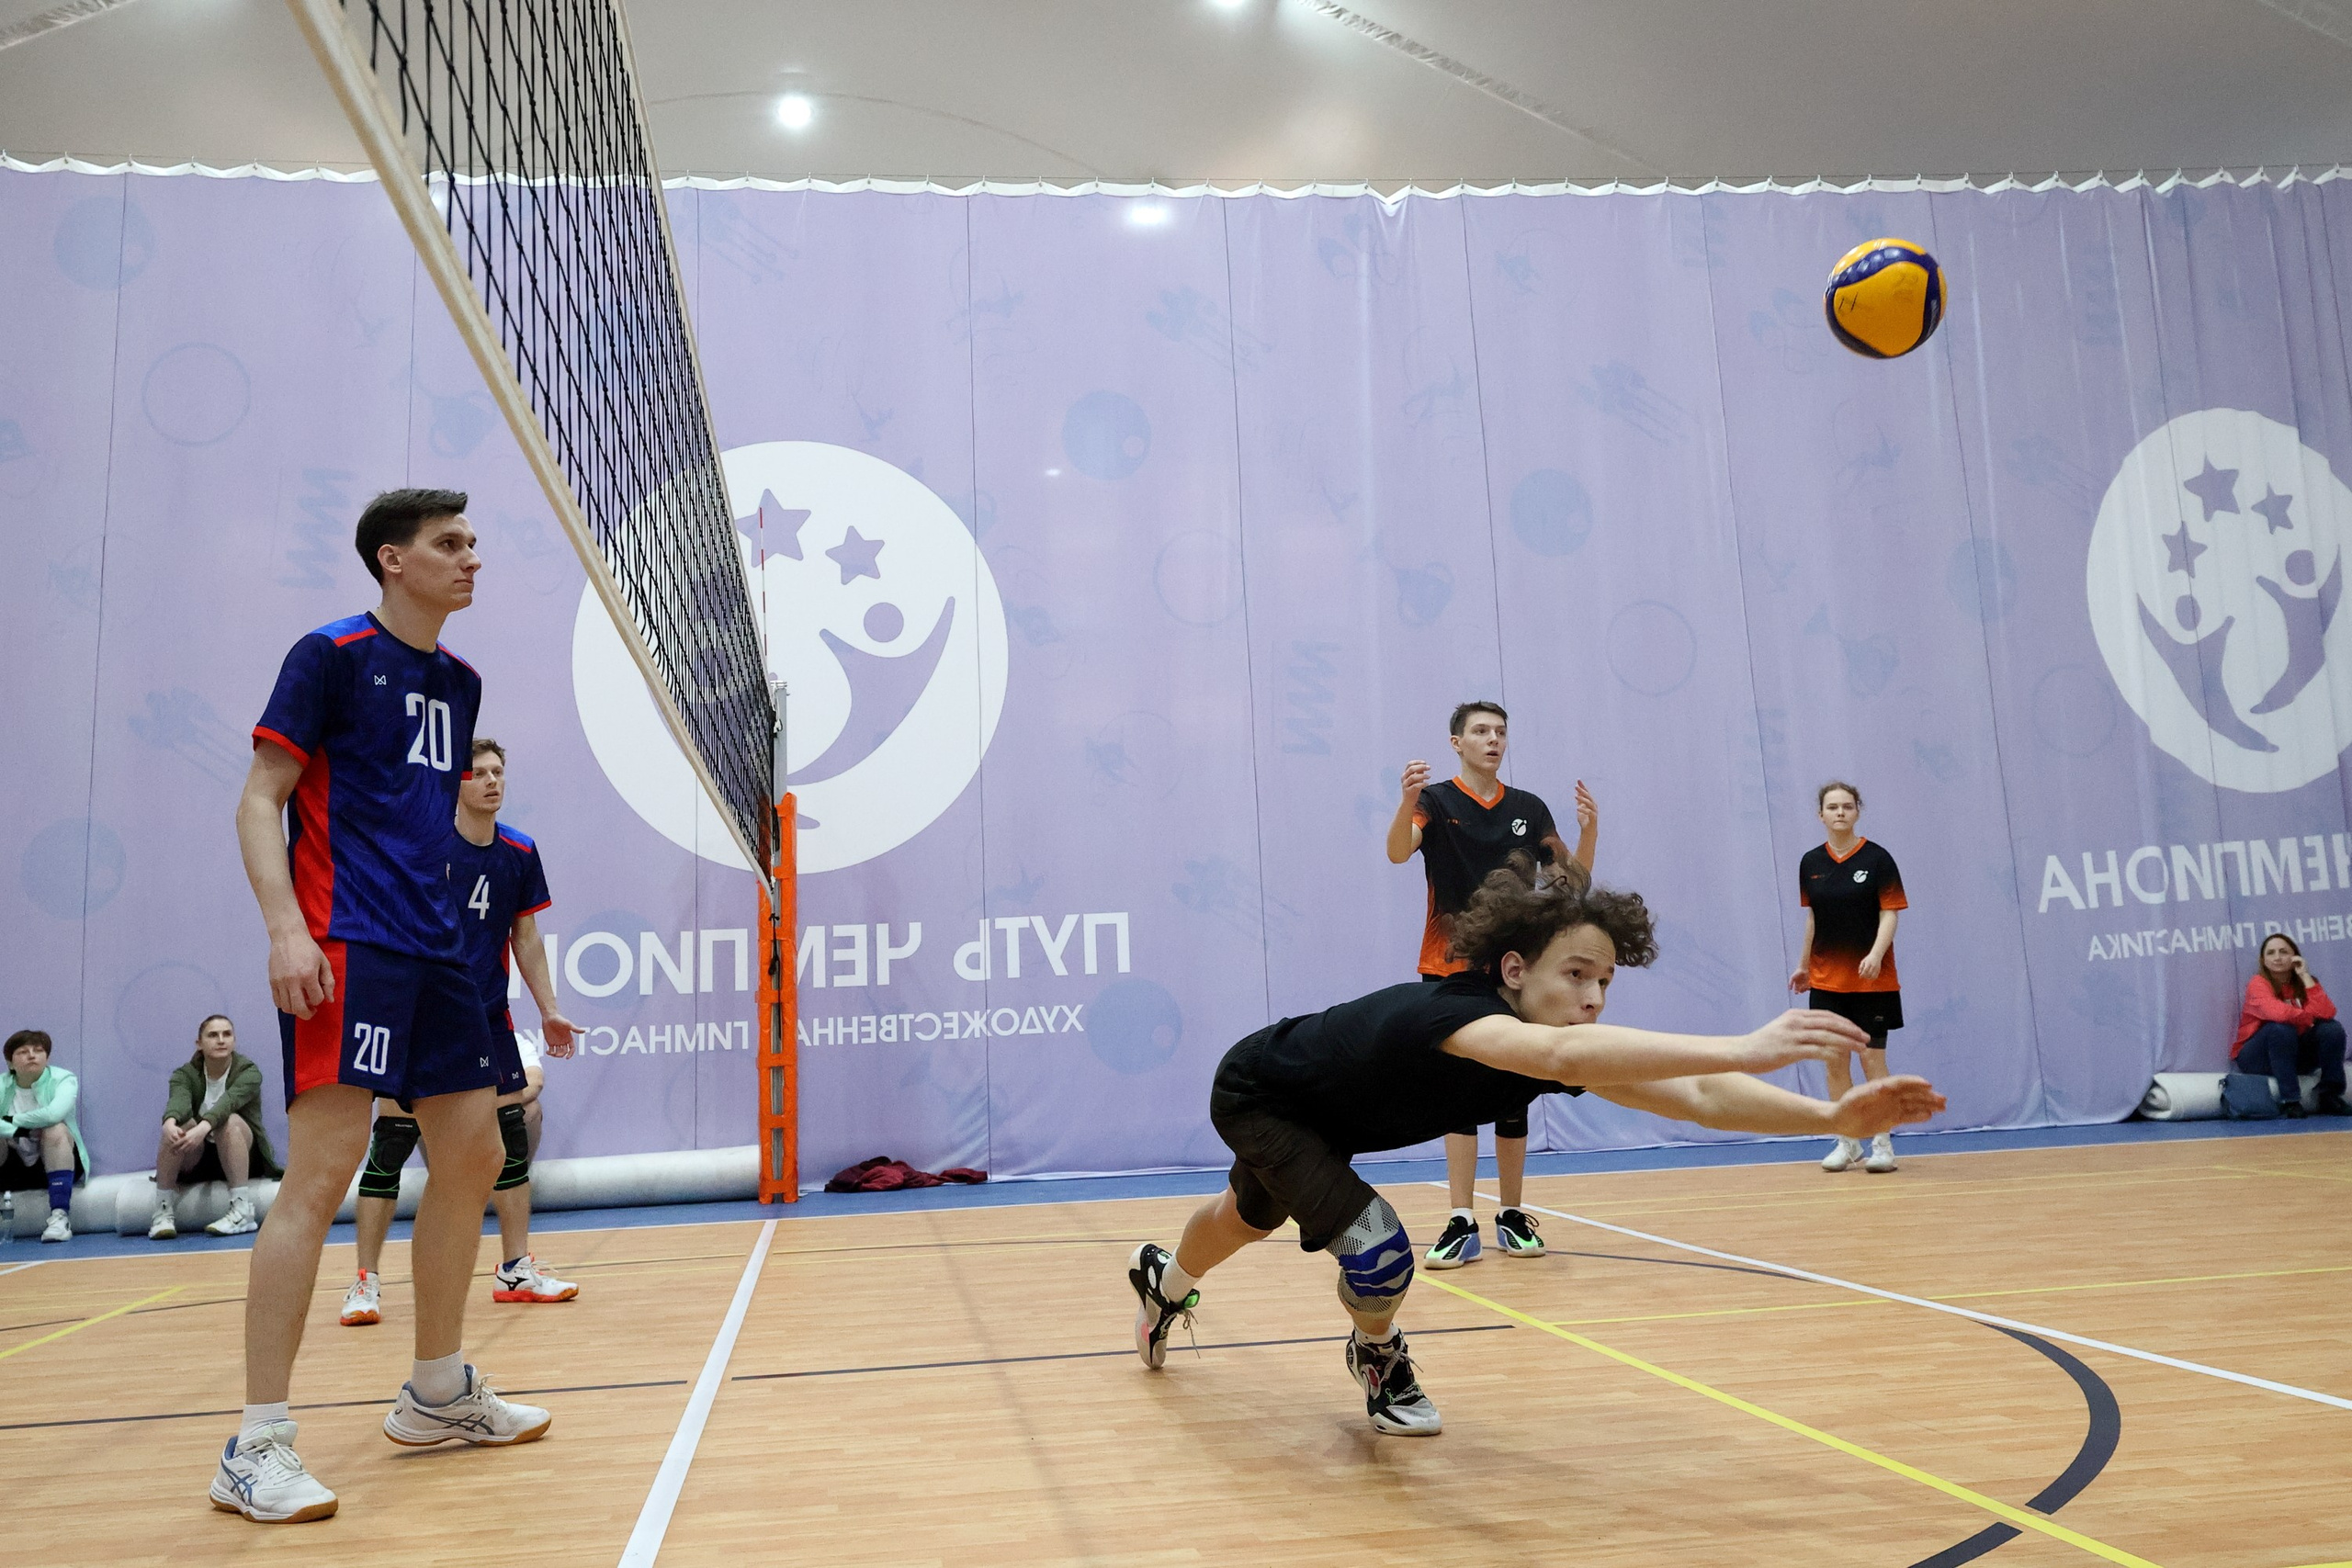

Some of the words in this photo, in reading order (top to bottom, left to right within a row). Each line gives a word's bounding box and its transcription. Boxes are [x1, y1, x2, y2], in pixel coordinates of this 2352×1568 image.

[405, 693, 452, 772] 20
[468, 874, 490, 920] 4
[354, 1022, 390, 1075] 20
